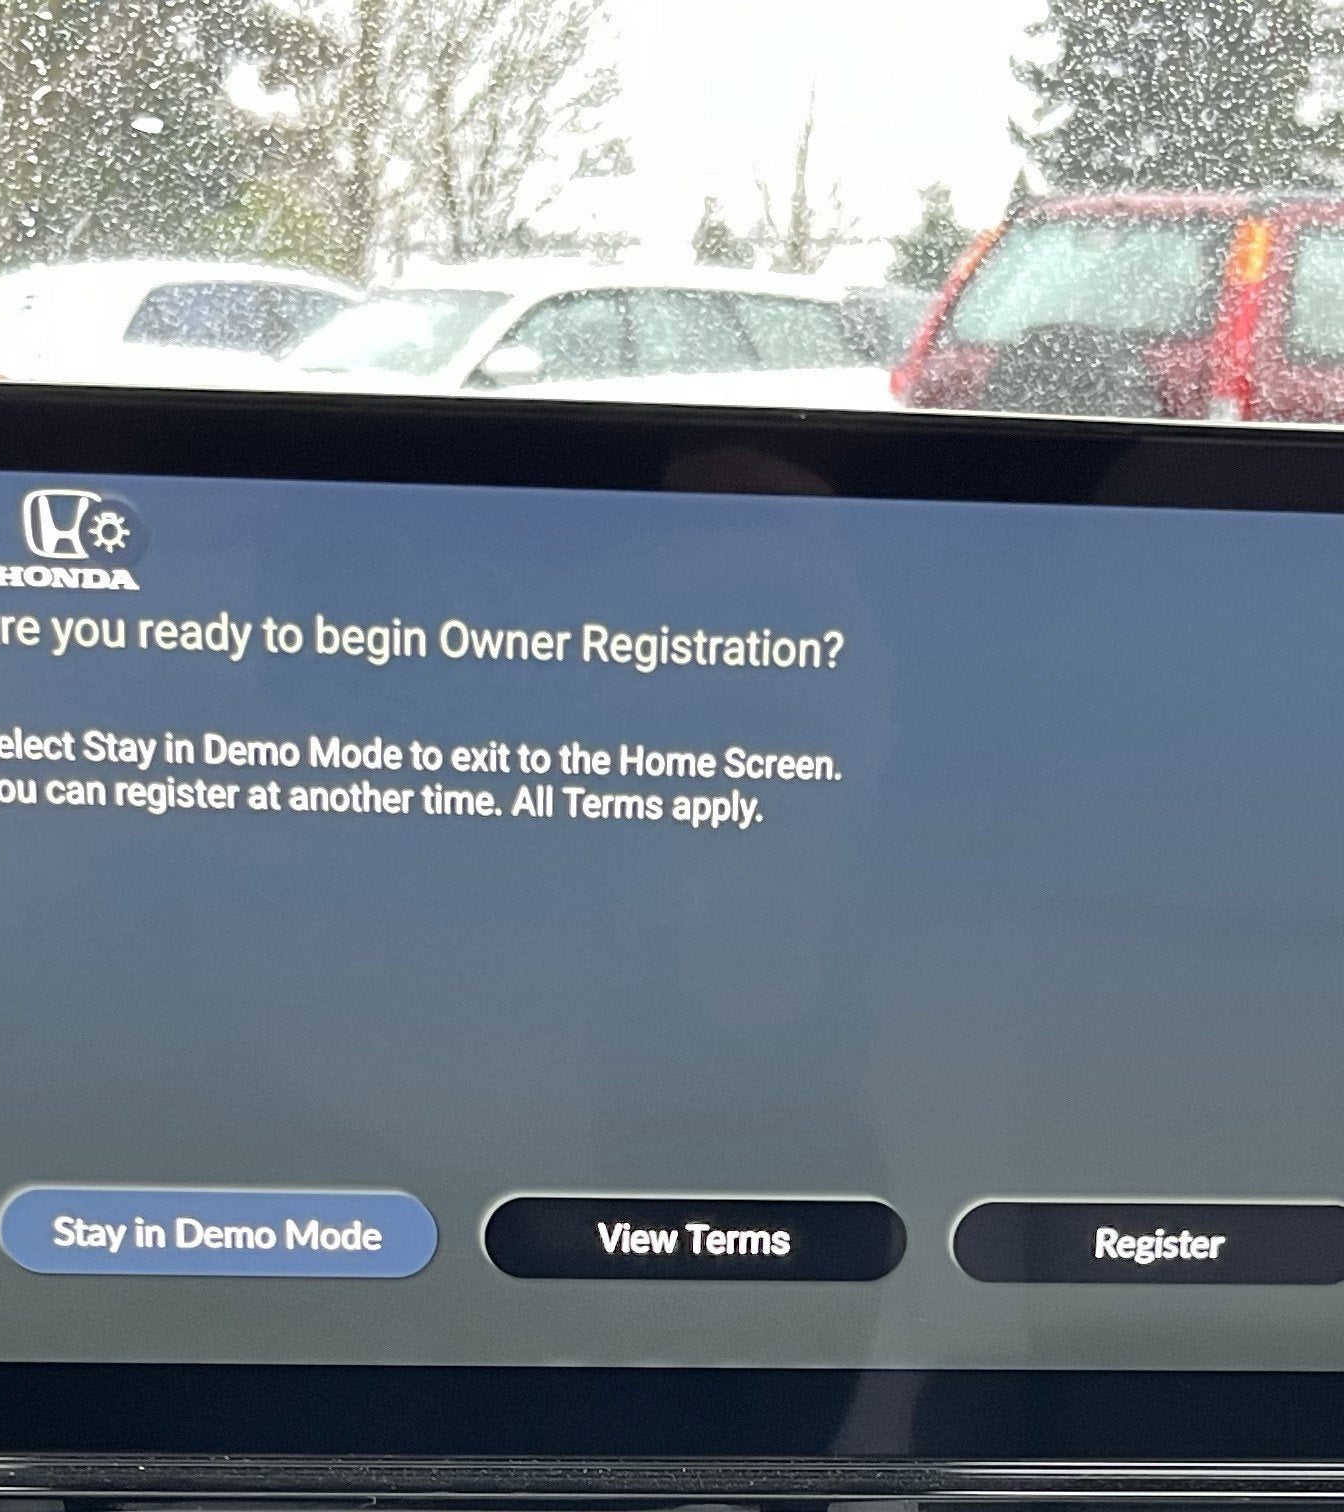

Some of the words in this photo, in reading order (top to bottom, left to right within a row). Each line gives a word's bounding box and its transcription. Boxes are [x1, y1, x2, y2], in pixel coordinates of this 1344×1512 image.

[50, 617, 126, 656] you
[139, 611, 253, 662] ready
[262, 617, 303, 654] to
[316, 613, 426, 666] begin
[440, 619, 571, 662] Owner
[583, 624, 844, 673] Registration?
[83, 729, 157, 771] Stay
[165, 731, 195, 764] in
[203, 733, 301, 767] Demo
[309, 735, 403, 770] Mode
[409, 739, 443, 771] to
[451, 740, 511, 773] exit
[517, 743, 552, 774] to
[558, 741, 611, 776] the
[620, 743, 717, 778] Home
[723, 746, 843, 781] Screen.
[45, 779, 107, 806] can
[114, 776, 241, 815] register
[247, 781, 282, 811] at
[288, 779, 415, 815] another
[420, 782, 503, 817] time.
[510, 784, 554, 818] All
[561, 786, 664, 820] Terms
[672, 788, 764, 830] apply.
[53, 1215, 128, 1254] Stay
[134, 1216, 167, 1249] in
[175, 1216, 277, 1250] Demo
[285, 1218, 383, 1251] Mode
[597, 1222, 679, 1254] View
[685, 1223, 791, 1255] Terms
[1094, 1227, 1226, 1265] Register
